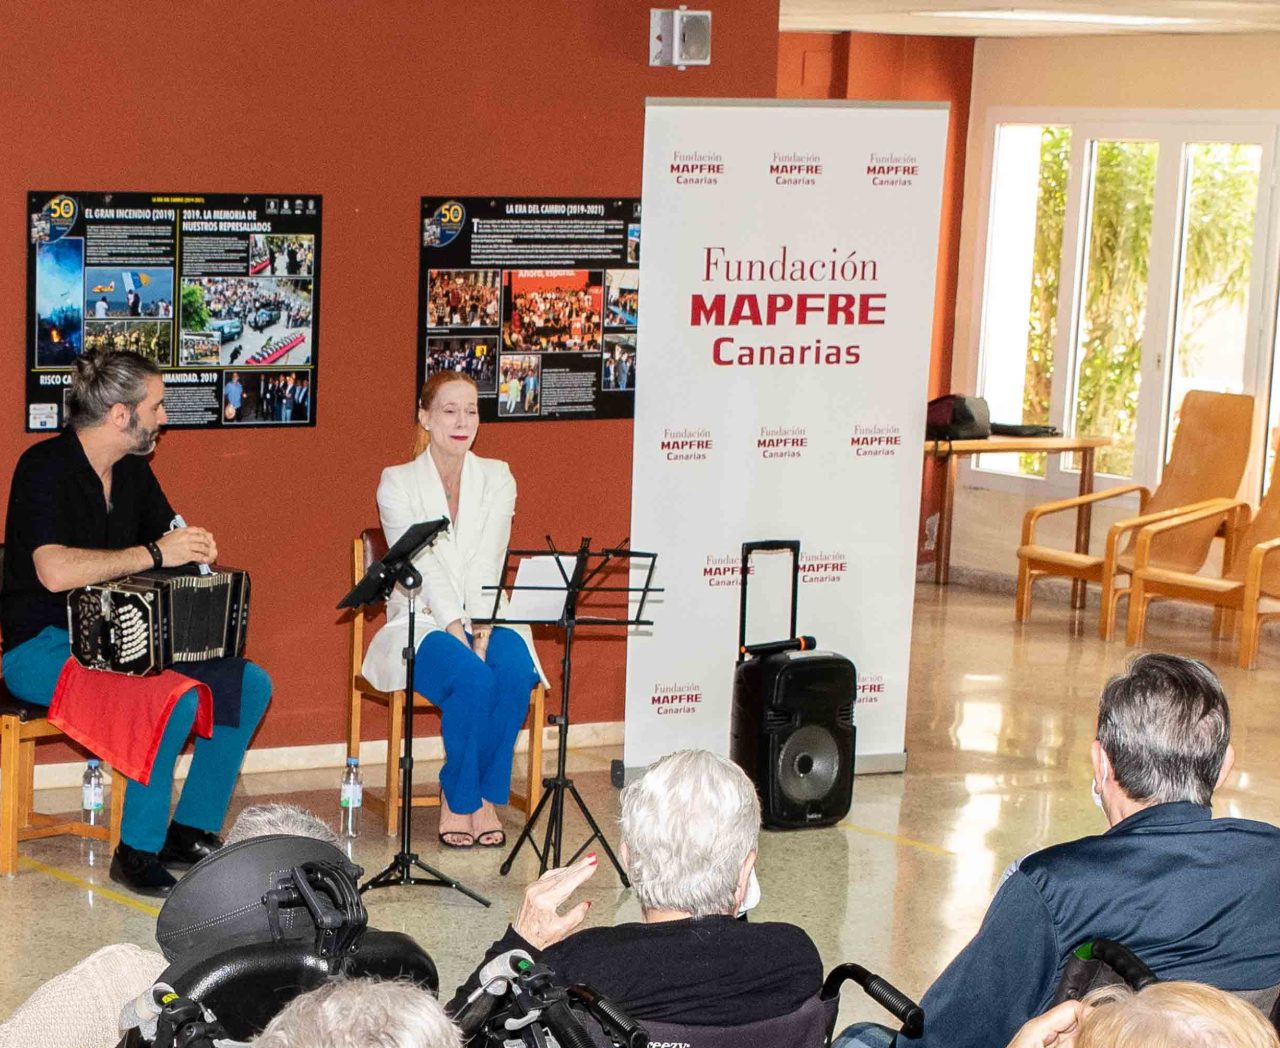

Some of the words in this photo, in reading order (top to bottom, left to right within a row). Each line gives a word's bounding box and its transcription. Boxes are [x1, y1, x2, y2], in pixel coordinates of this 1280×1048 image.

[673, 151, 722, 163] Fundación
[773, 152, 821, 163] Fundación
[870, 153, 917, 164] Fundación
[670, 164, 725, 175] MAPFRE
[769, 165, 823, 175] MAPFRE
[866, 165, 919, 176] MAPFRE
[676, 175, 718, 185] Canarias
[775, 176, 816, 186] Canarias
[872, 177, 912, 186] Canarias
[50, 199, 74, 218] 50
[440, 205, 463, 223] 50
[505, 204, 514, 215] LA
[515, 204, 527, 215] ERA
[528, 204, 540, 215] DEL
[540, 204, 566, 215] CAMBIO
[566, 204, 605, 217] (2019-2021)
[85, 208, 94, 219] EL
[94, 208, 115, 220] GRAN
[116, 208, 152, 221] INCENDIO
[152, 209, 175, 222] (2019)
[182, 210, 202, 220] 2019.
[203, 210, 212, 221] LA
[212, 210, 247, 221] MEMORIA
[247, 210, 257, 221] DE
[182, 221, 218, 232] NUESTROS
[218, 222, 272, 232] REPRESALIADOS
[702, 246, 879, 282] Fundación
[690, 293, 887, 326] MAPFRE
[712, 337, 861, 366] Canarias
[39, 374, 61, 385] RISCO
[200, 373, 217, 383] 2019
[664, 428, 711, 439] Fundación
[760, 426, 806, 437] Fundación
[853, 425, 900, 436] Fundación
[660, 440, 713, 450] MAPFRE
[757, 437, 808, 448] MAPFRE
[850, 436, 902, 446] MAPFRE
[666, 451, 707, 461] Canarias
[762, 449, 802, 459] Canarias
[856, 447, 896, 457] Canarias
[800, 552, 846, 563] Fundación
[703, 566, 755, 576] MAPFE
[802, 573, 841, 584] Canarias
[654, 682, 701, 694] Fundación
[651, 693, 702, 705] MAPFRE
[657, 705, 696, 715] Canarias
